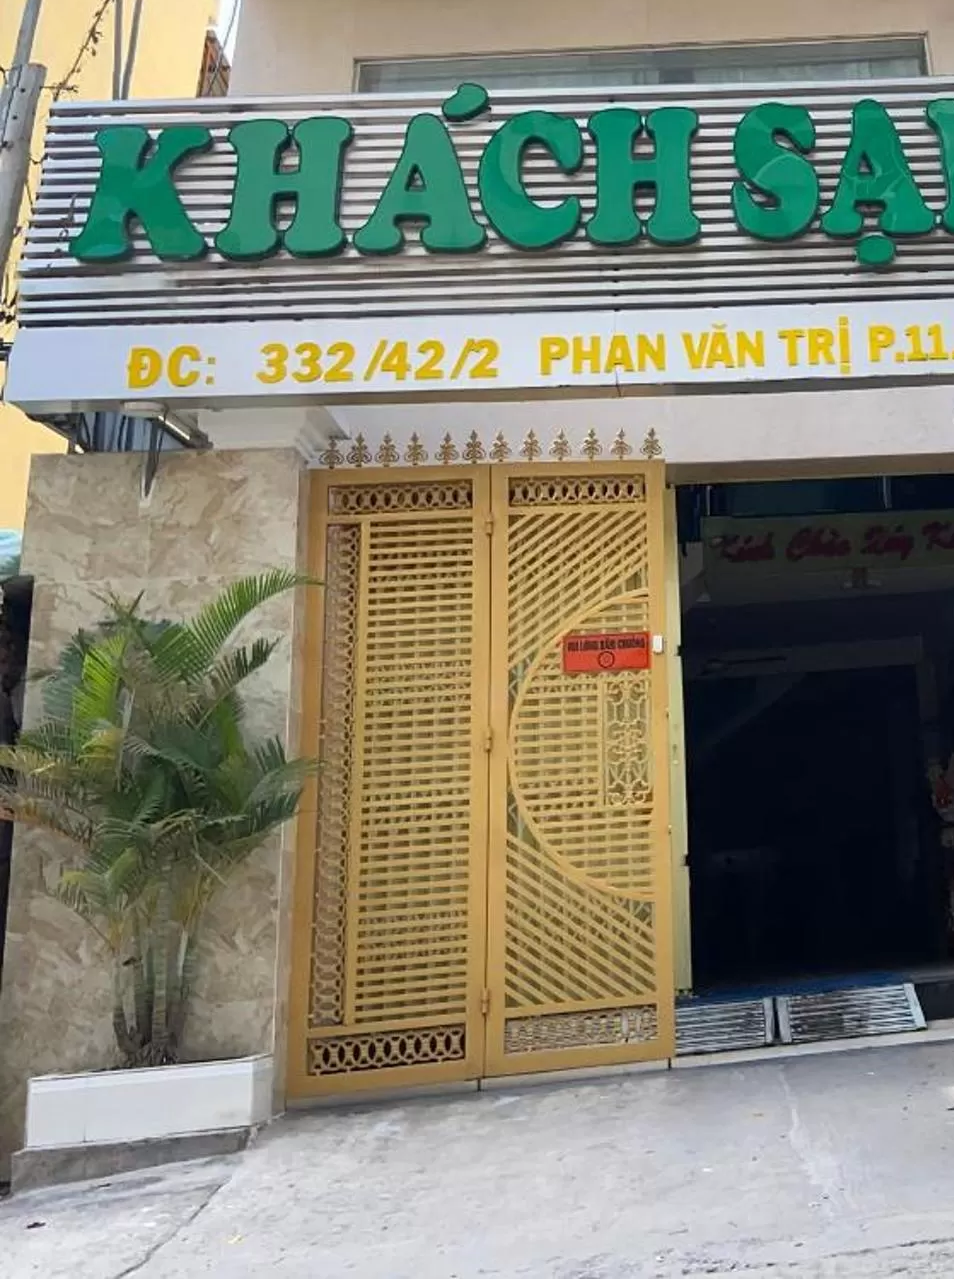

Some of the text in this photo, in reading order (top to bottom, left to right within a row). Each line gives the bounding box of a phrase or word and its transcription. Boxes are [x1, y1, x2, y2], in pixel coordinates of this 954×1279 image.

[68, 82, 702, 263] KHÁCH
[127, 344, 216, 389] ĐC:
[539, 332, 667, 376] PHAN
[681, 323, 764, 369] VĂN
[778, 315, 851, 374] TRỊ
